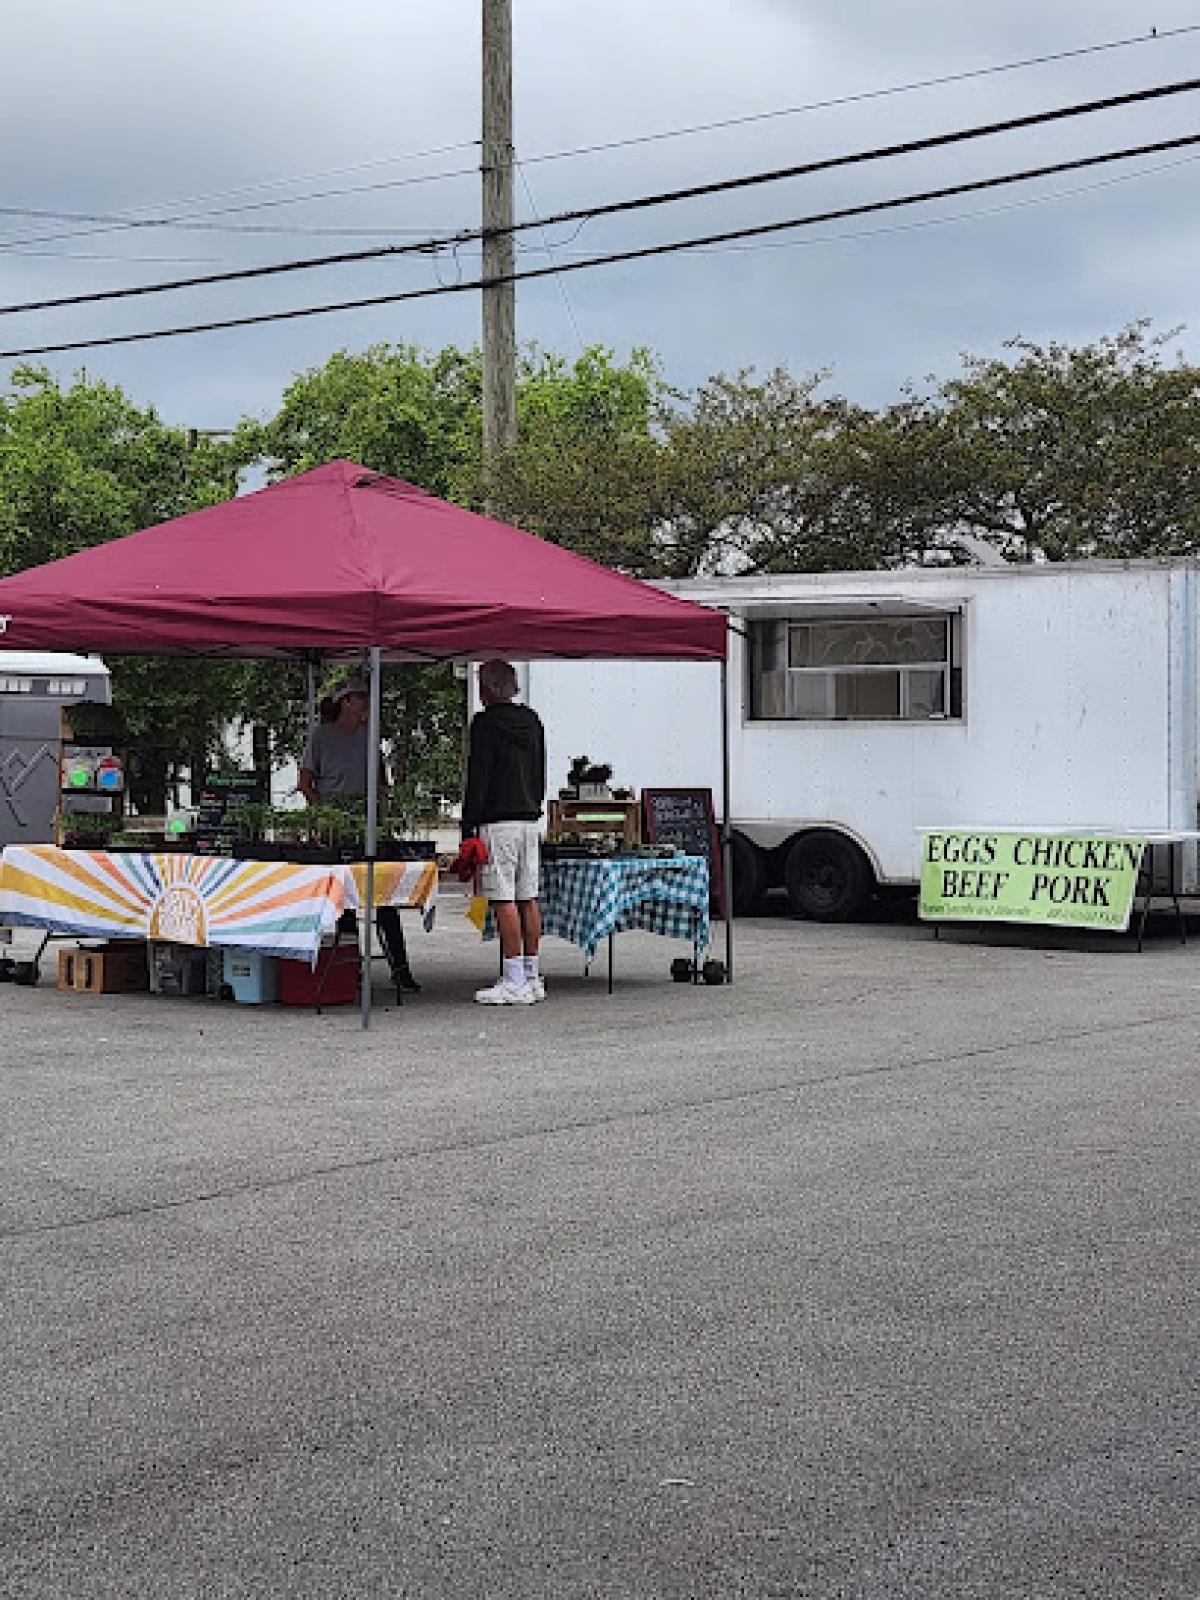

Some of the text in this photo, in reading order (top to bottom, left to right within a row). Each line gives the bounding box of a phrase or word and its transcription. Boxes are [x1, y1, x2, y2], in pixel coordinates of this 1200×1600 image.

[927, 835, 1143, 871] EGGS CHICKEN
[941, 870, 1112, 906] BEEF PORK
